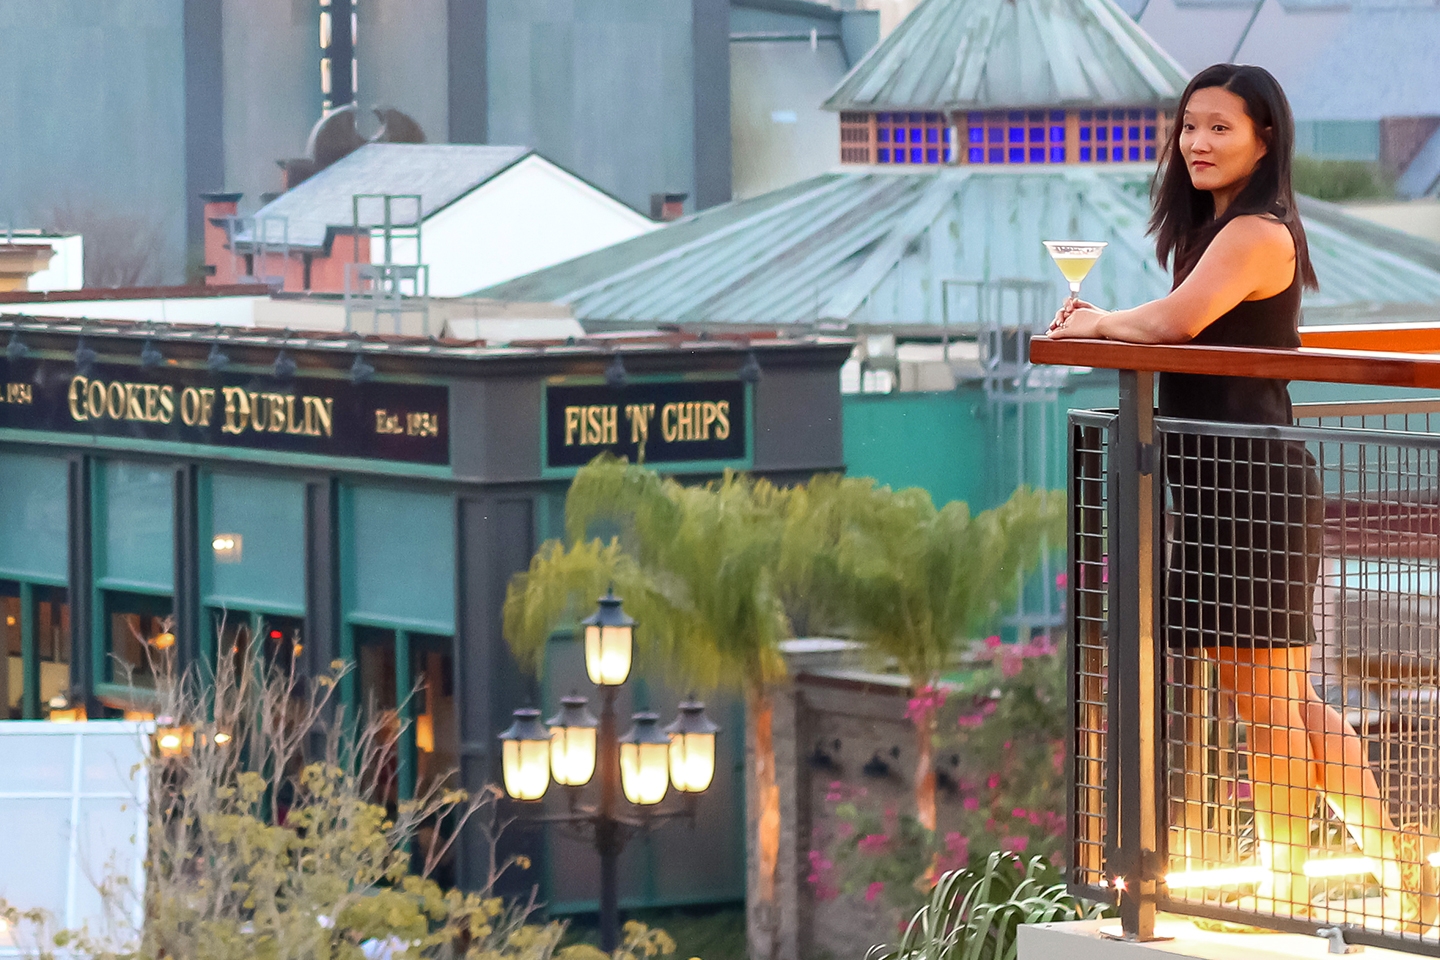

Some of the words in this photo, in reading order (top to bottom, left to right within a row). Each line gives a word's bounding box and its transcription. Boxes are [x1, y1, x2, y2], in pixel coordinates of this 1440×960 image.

[68, 375, 174, 424] COOKES
[180, 387, 215, 427] OF
[221, 386, 334, 437] DUBLIN
[565, 405, 618, 445] FISH
[625, 403, 655, 443] 'N'
[661, 400, 730, 442] CHIPS
